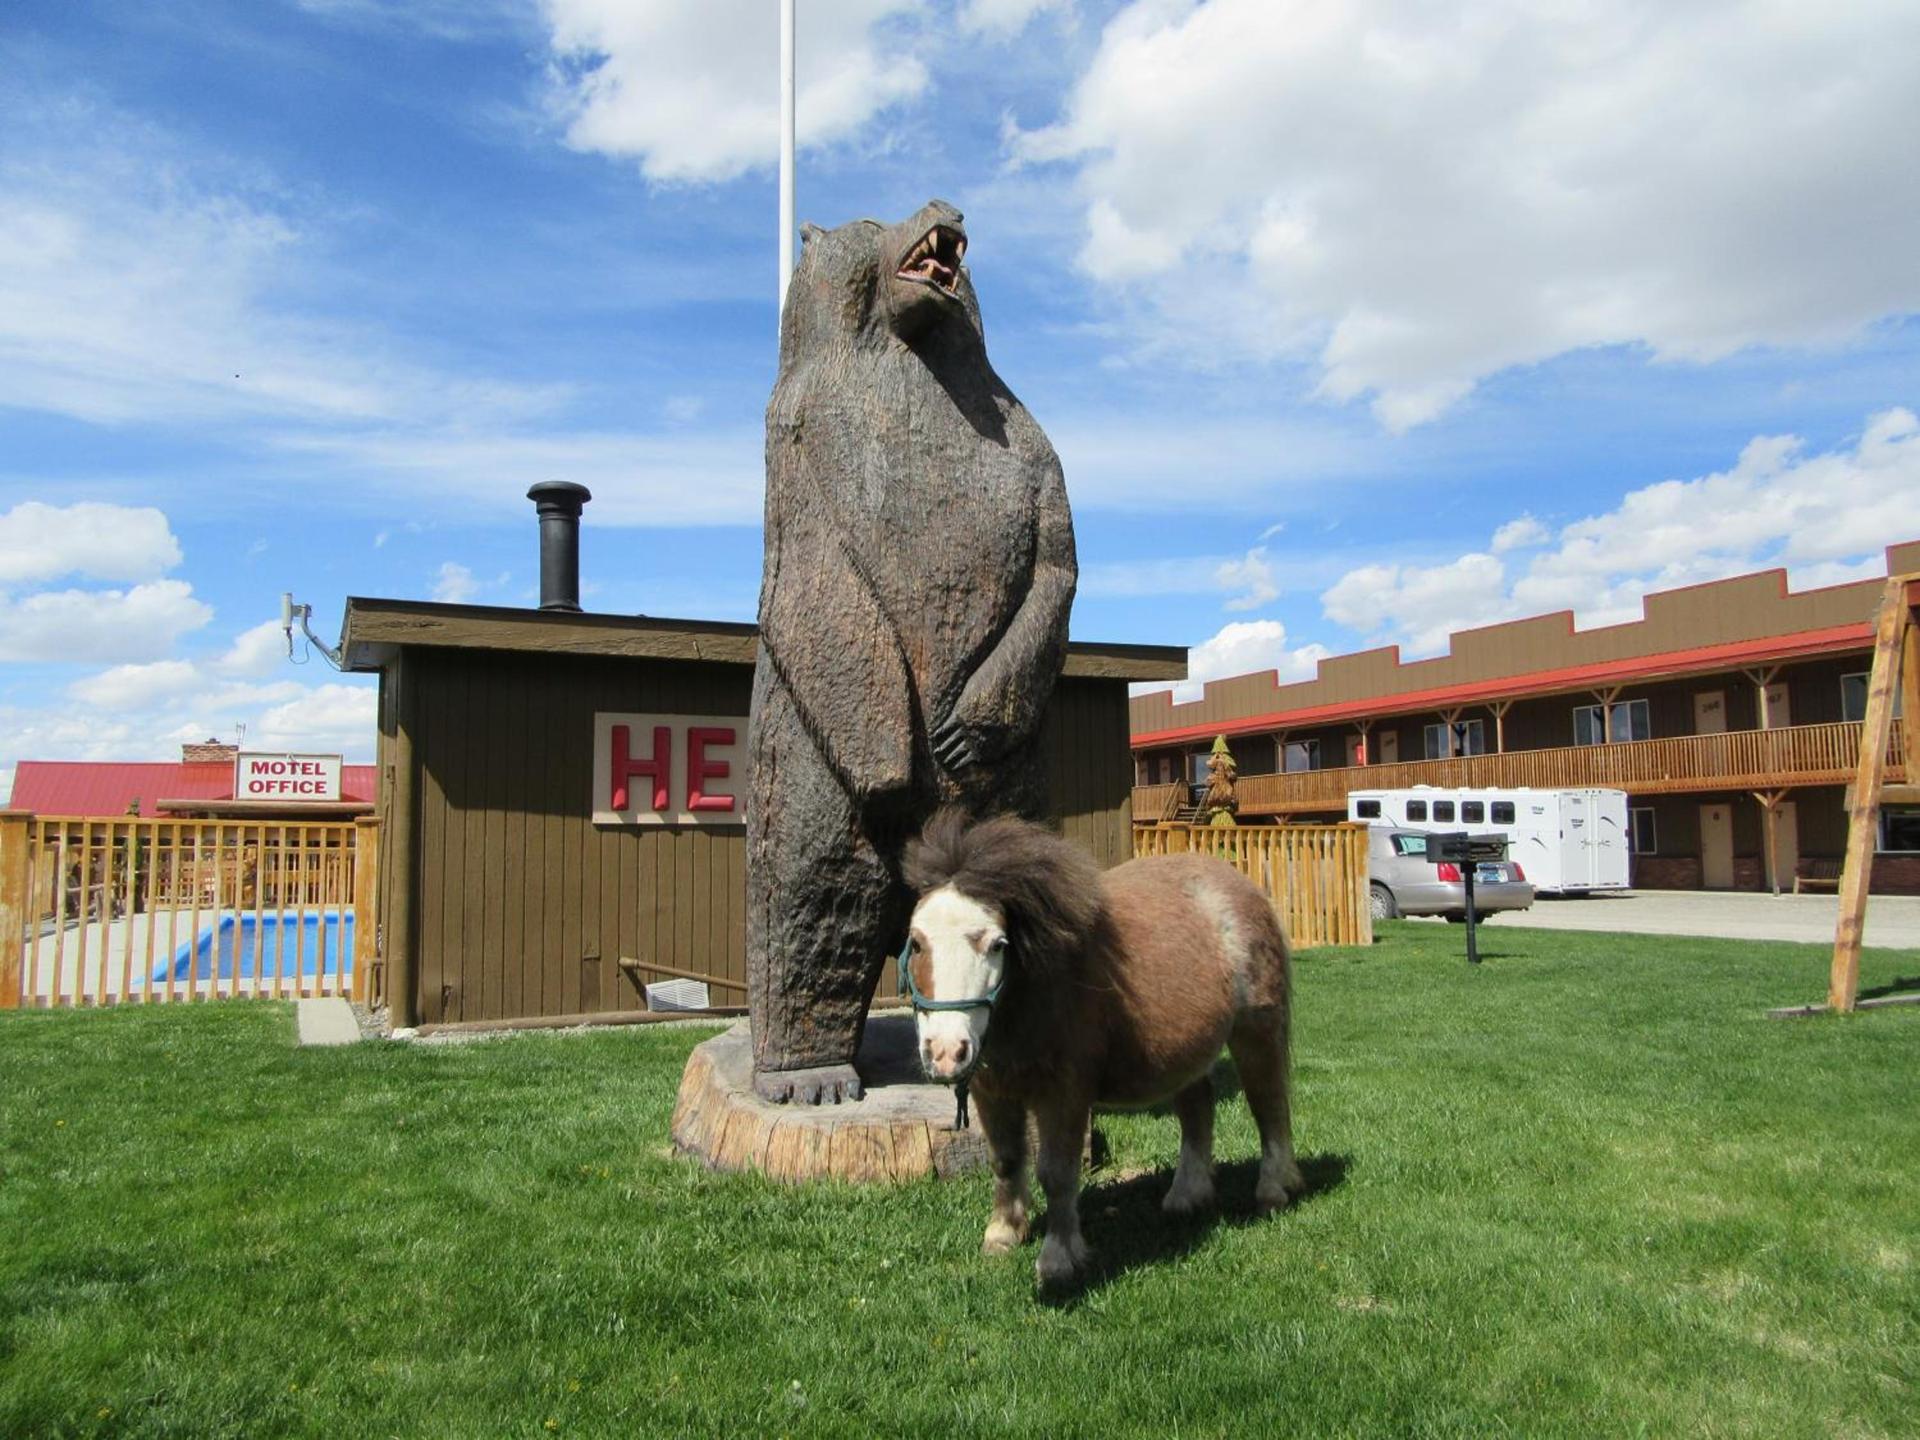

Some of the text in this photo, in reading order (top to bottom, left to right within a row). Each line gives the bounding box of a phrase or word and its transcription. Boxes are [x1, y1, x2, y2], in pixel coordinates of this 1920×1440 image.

[251, 761, 327, 775] MOTEL
[611, 725, 736, 811] HE
[248, 780, 327, 794] OFFICE
